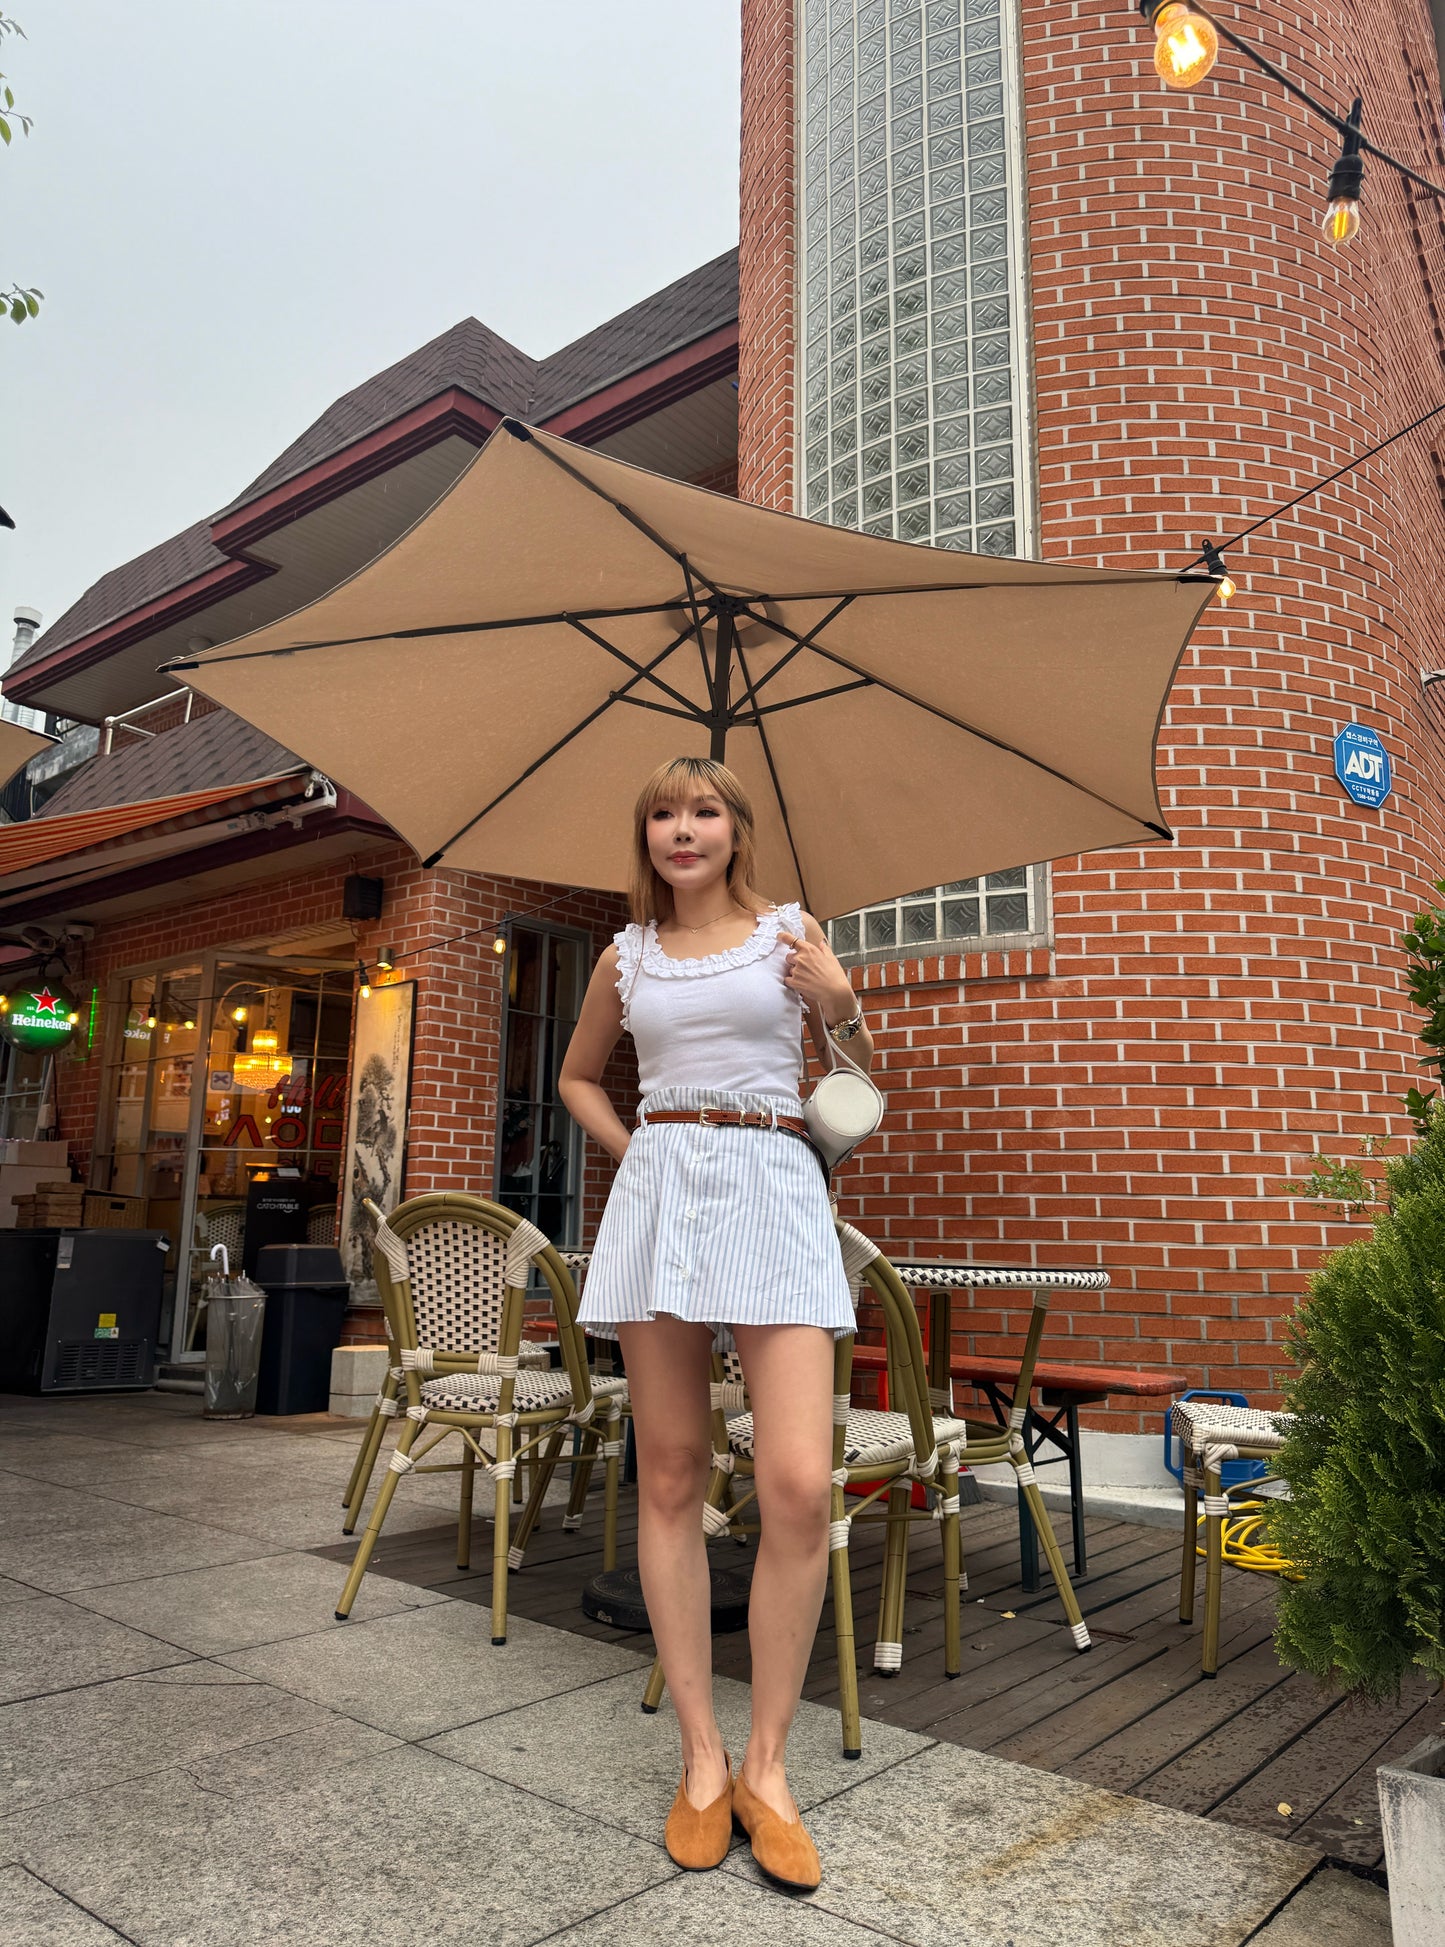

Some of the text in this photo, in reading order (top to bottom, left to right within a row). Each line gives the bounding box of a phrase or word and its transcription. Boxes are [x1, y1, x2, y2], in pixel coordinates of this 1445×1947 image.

[1344, 750, 1383, 783] ADT
[12, 1013, 72, 1030] Heineken
[266, 1074, 348, 1110] Hell
